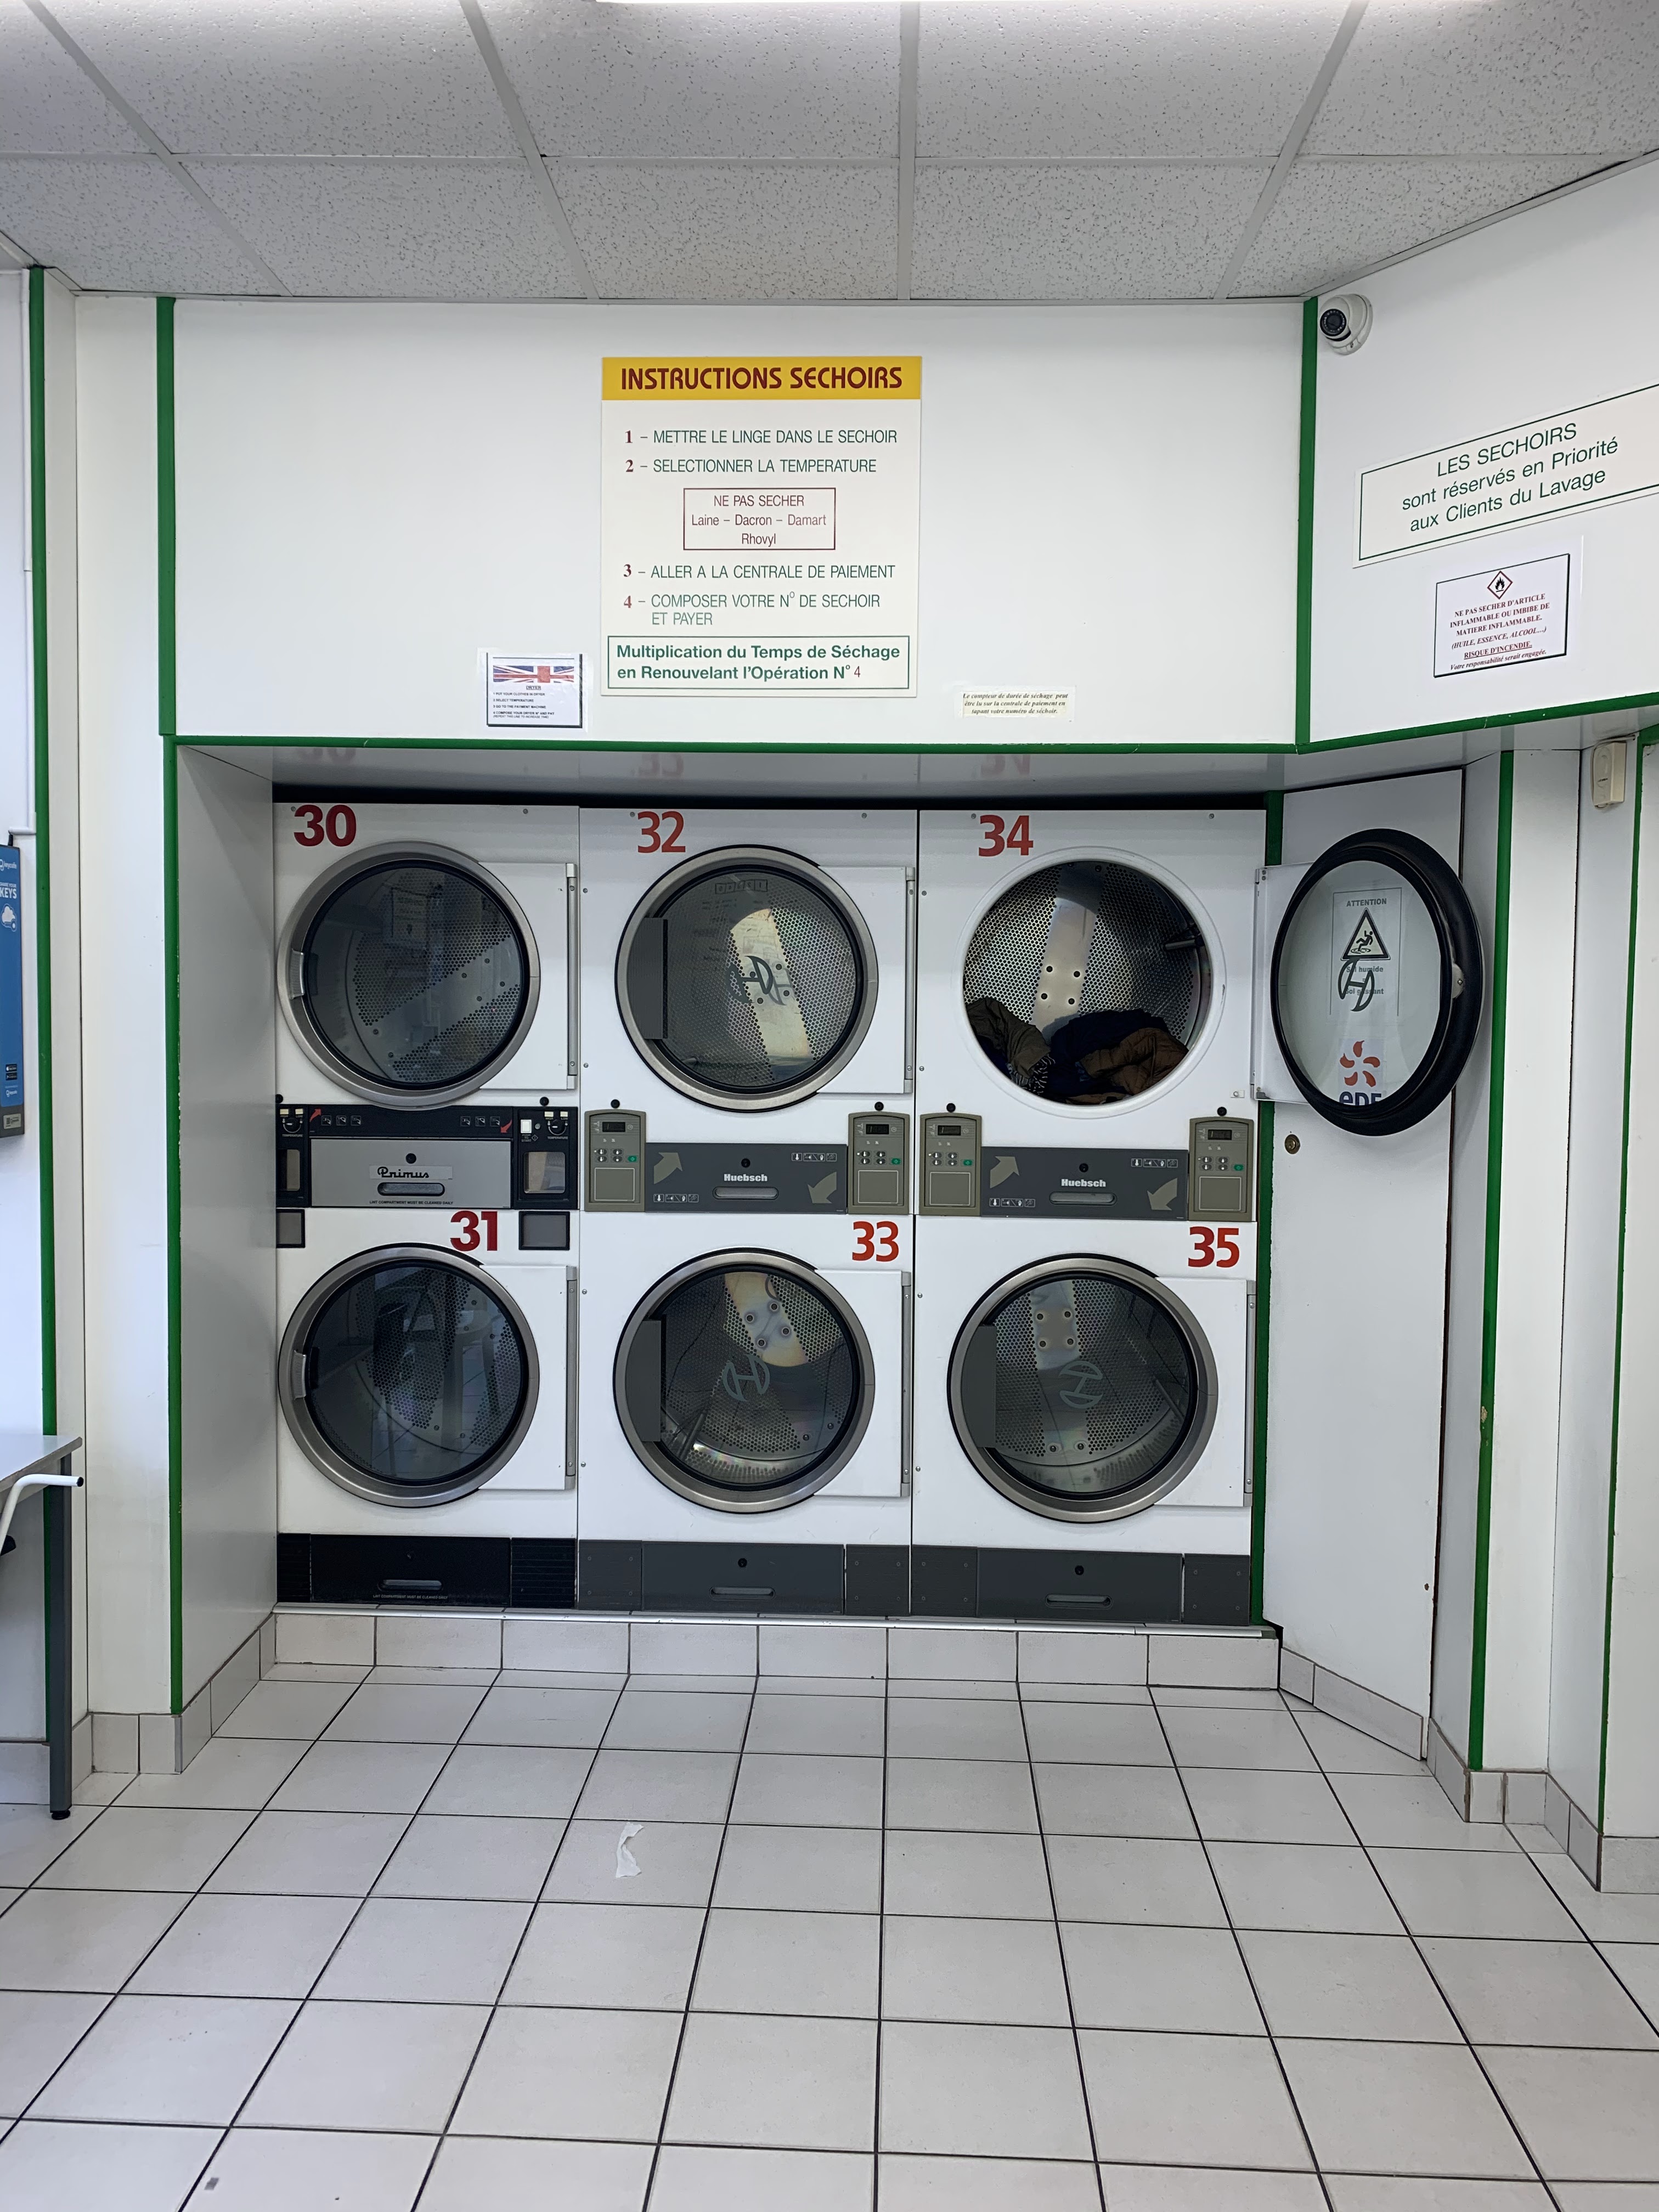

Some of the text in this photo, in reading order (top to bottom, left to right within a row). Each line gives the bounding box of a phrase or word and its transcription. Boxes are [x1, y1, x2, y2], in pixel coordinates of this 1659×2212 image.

[622, 366, 902, 390] INSTRUCTIONS SECHOIRS
[627, 431, 632, 443] 1
[654, 431, 706, 443] METTRE
[712, 431, 727, 443] LE
[733, 430, 770, 443] LINGE
[777, 430, 812, 443] DANS
[818, 430, 833, 443] LE
[838, 430, 896, 443] SECHOIR
[1437, 423, 1577, 477] LES SECHOIRS
[626, 460, 633, 472] 2
[653, 459, 752, 472] SELECTIONNER
[759, 460, 774, 472] LA
[780, 460, 876, 472] TEMPERATURE
[1402, 437, 1618, 510] sont réservés en Priorité
[714, 495, 804, 506] NE PAS SECHER
[1410, 470, 1606, 532] aux Clients du Lavage
[692, 515, 719, 526] Laine
[736, 515, 771, 525] Dacron
[788, 514, 826, 526] Damart
[742, 533, 775, 547] Rhovyl
[624, 565, 631, 577] 3
[651, 566, 691, 578] ALLER
[697, 566, 706, 578] A
[712, 566, 728, 578] LA
[734, 566, 802, 578] CENTRALE
[809, 566, 825, 578] DE
[831, 565, 895, 578] PAIEMENT
[624, 596, 631, 608] 4
[652, 594, 726, 607] COMPOSER
[732, 595, 774, 607] VOTRE
[800, 595, 816, 607] DE
[822, 594, 879, 607] SECHOIR
[1479, 602, 1505, 612] SECHER
[1508, 594, 1545, 606] D'ARTICLE
[652, 612, 712, 625] ET PAYER
[1450, 613, 1499, 628] INFLAMMABLE
[1513, 605, 1538, 616] IMBIBE
[1457, 615, 1542, 636] MATIERE INFLAMMABLE.
[1452, 640, 1476, 650] (HUILE,
[1477, 633, 1509, 645] ESSENCE,
[1464, 641, 1532, 658] RISQUE D'INCENDIE.
[618, 645, 900, 661] Multiplication du Temps de Séchage
[1466, 654, 1503, 668] responsabilité
[1505, 653, 1520, 661] serait
[1522, 648, 1547, 658] engagée.
[618, 669, 635, 678] en
[642, 666, 738, 679] Renouvelant
[854, 666, 860, 677] 4
[294, 805, 356, 847] 30
[637, 811, 685, 853] 32
[979, 815, 1033, 856] 34
[0, 887, 16, 899] KEYS
[1346, 898, 1386, 907] ATTENTION
[377, 1166, 429, 1178] Primus
[724, 1173, 768, 1182] Huebsch
[1061, 1178, 1106, 1187] Huebsch
[450, 1211, 498, 1251] 31
[853, 1221, 899, 1262] 33
[1188, 1227, 1239, 1267] 35
